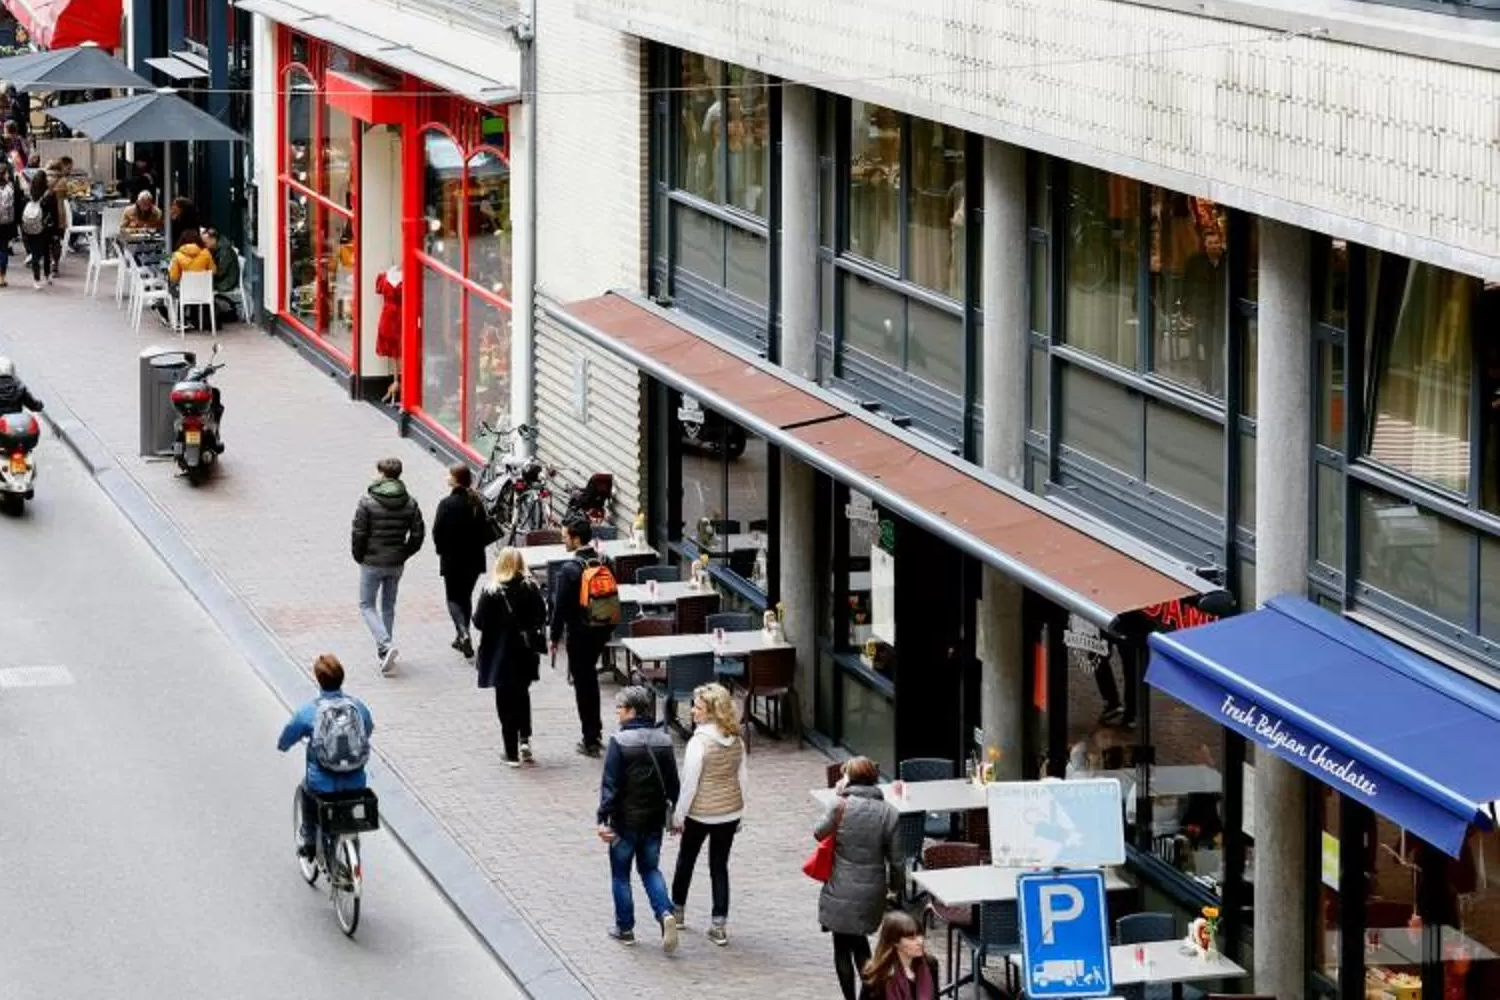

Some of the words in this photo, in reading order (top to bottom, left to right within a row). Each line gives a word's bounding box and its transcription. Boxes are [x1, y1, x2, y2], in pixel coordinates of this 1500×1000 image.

[1221, 694, 1257, 728] Fresh
[1255, 713, 1307, 757] Belgian
[1308, 743, 1377, 796] Chocolates
[1039, 884, 1085, 945] P
